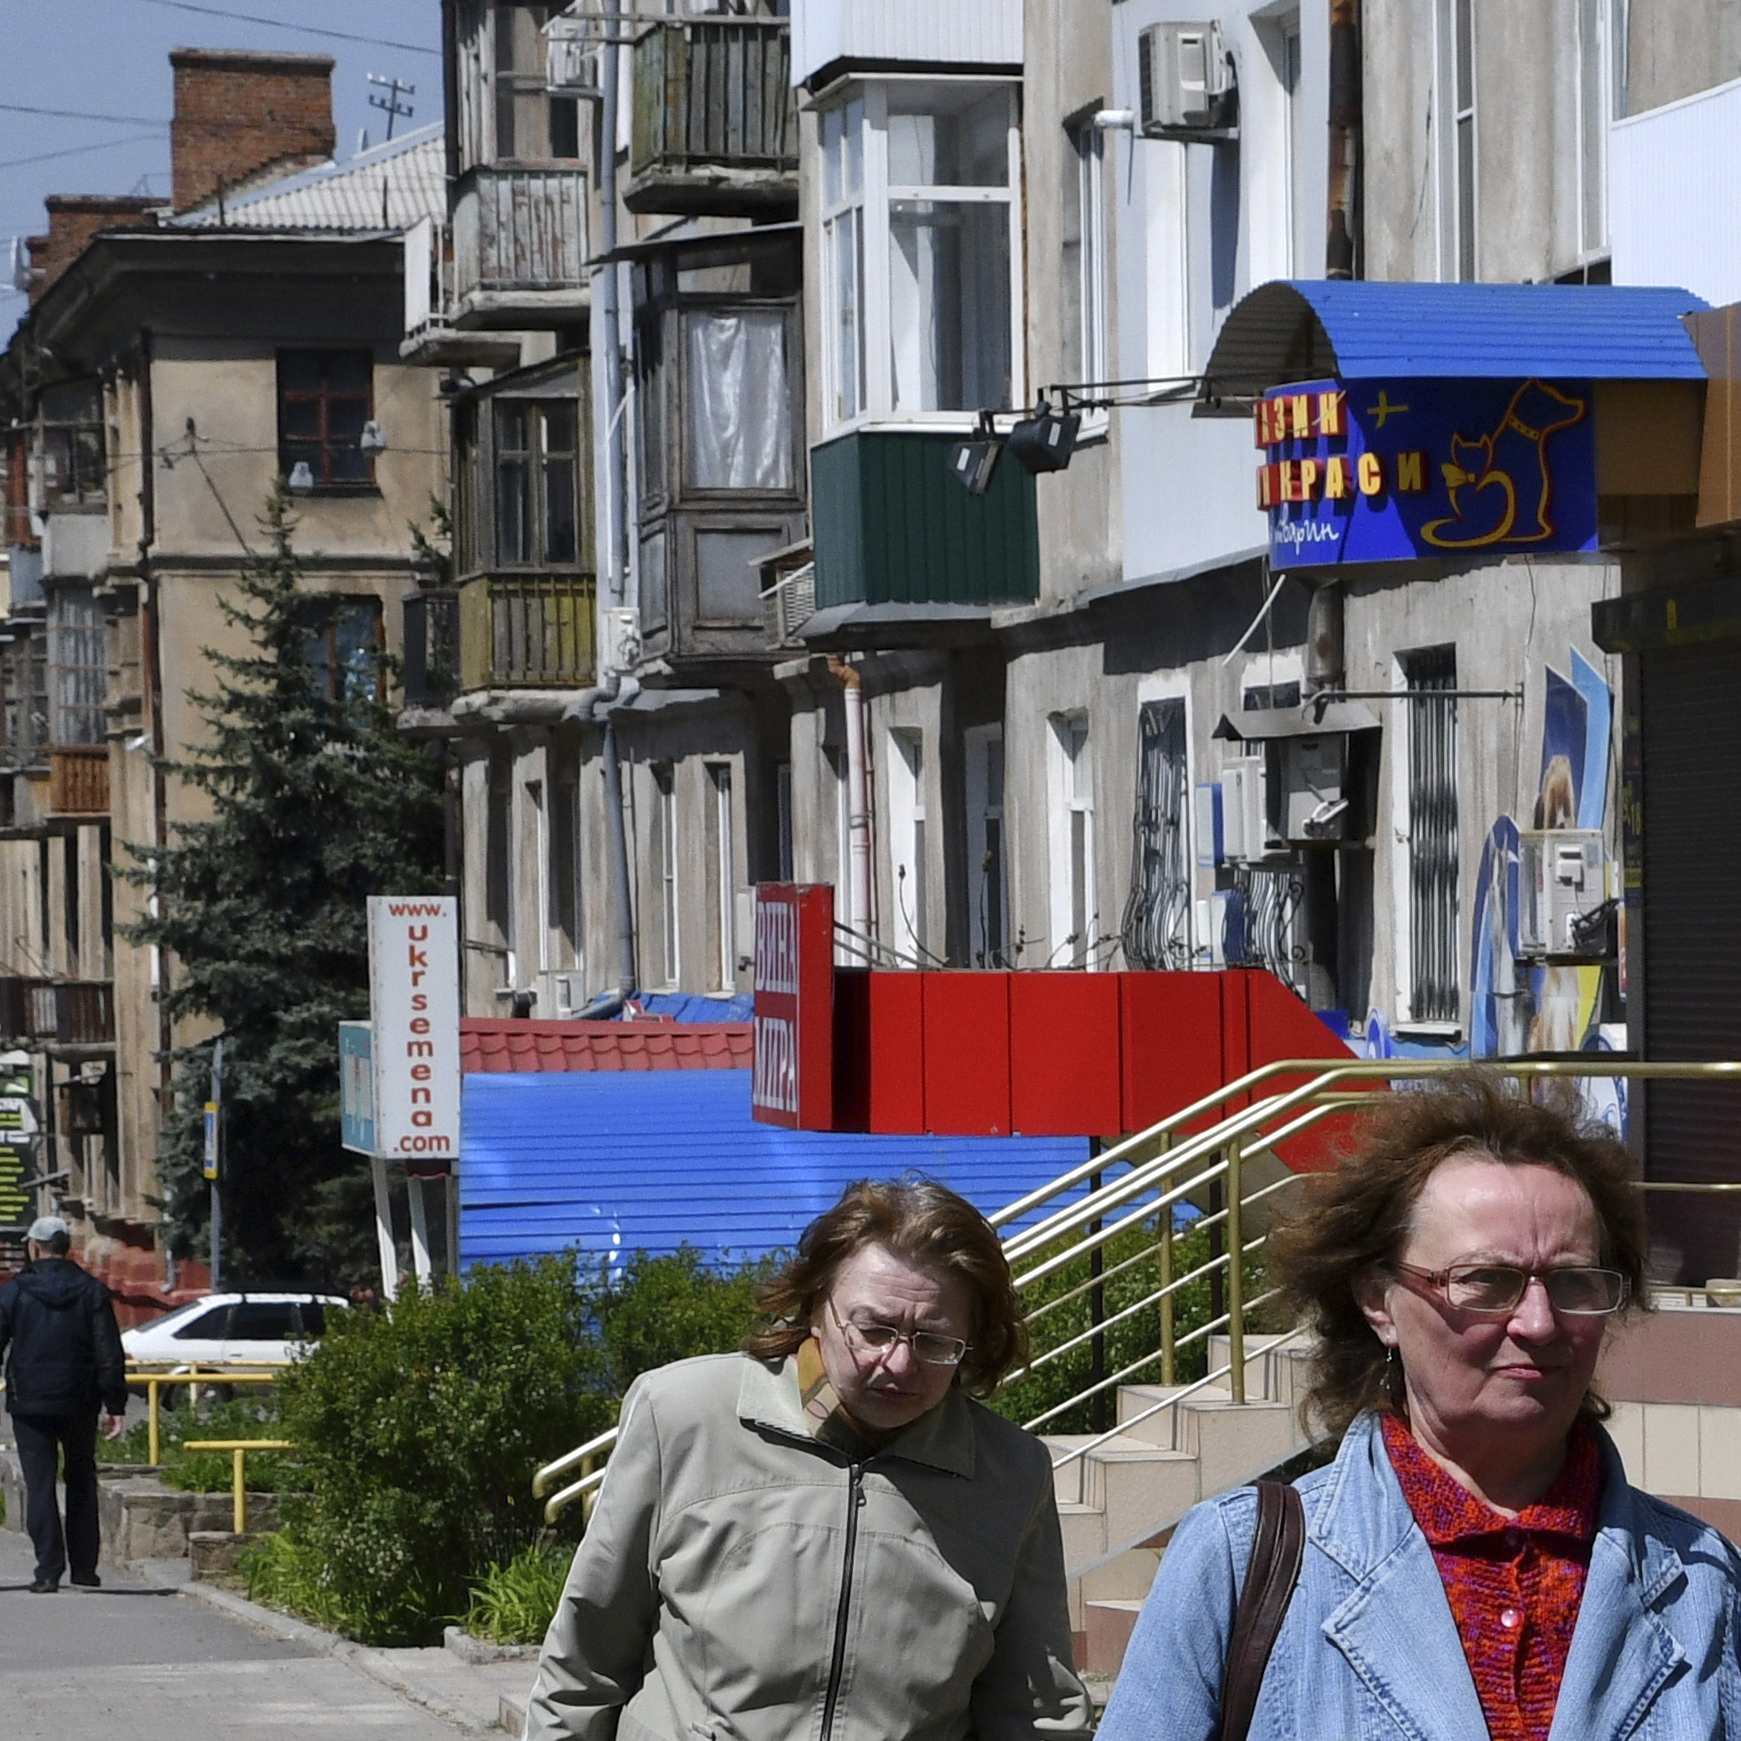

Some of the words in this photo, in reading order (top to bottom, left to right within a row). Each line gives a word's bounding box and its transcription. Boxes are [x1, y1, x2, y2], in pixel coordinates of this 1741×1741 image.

[388, 903, 448, 918] www.
[755, 901, 797, 993] ВИНА
[753, 1016, 798, 1112] МИРА
[392, 1135, 451, 1153] .com
